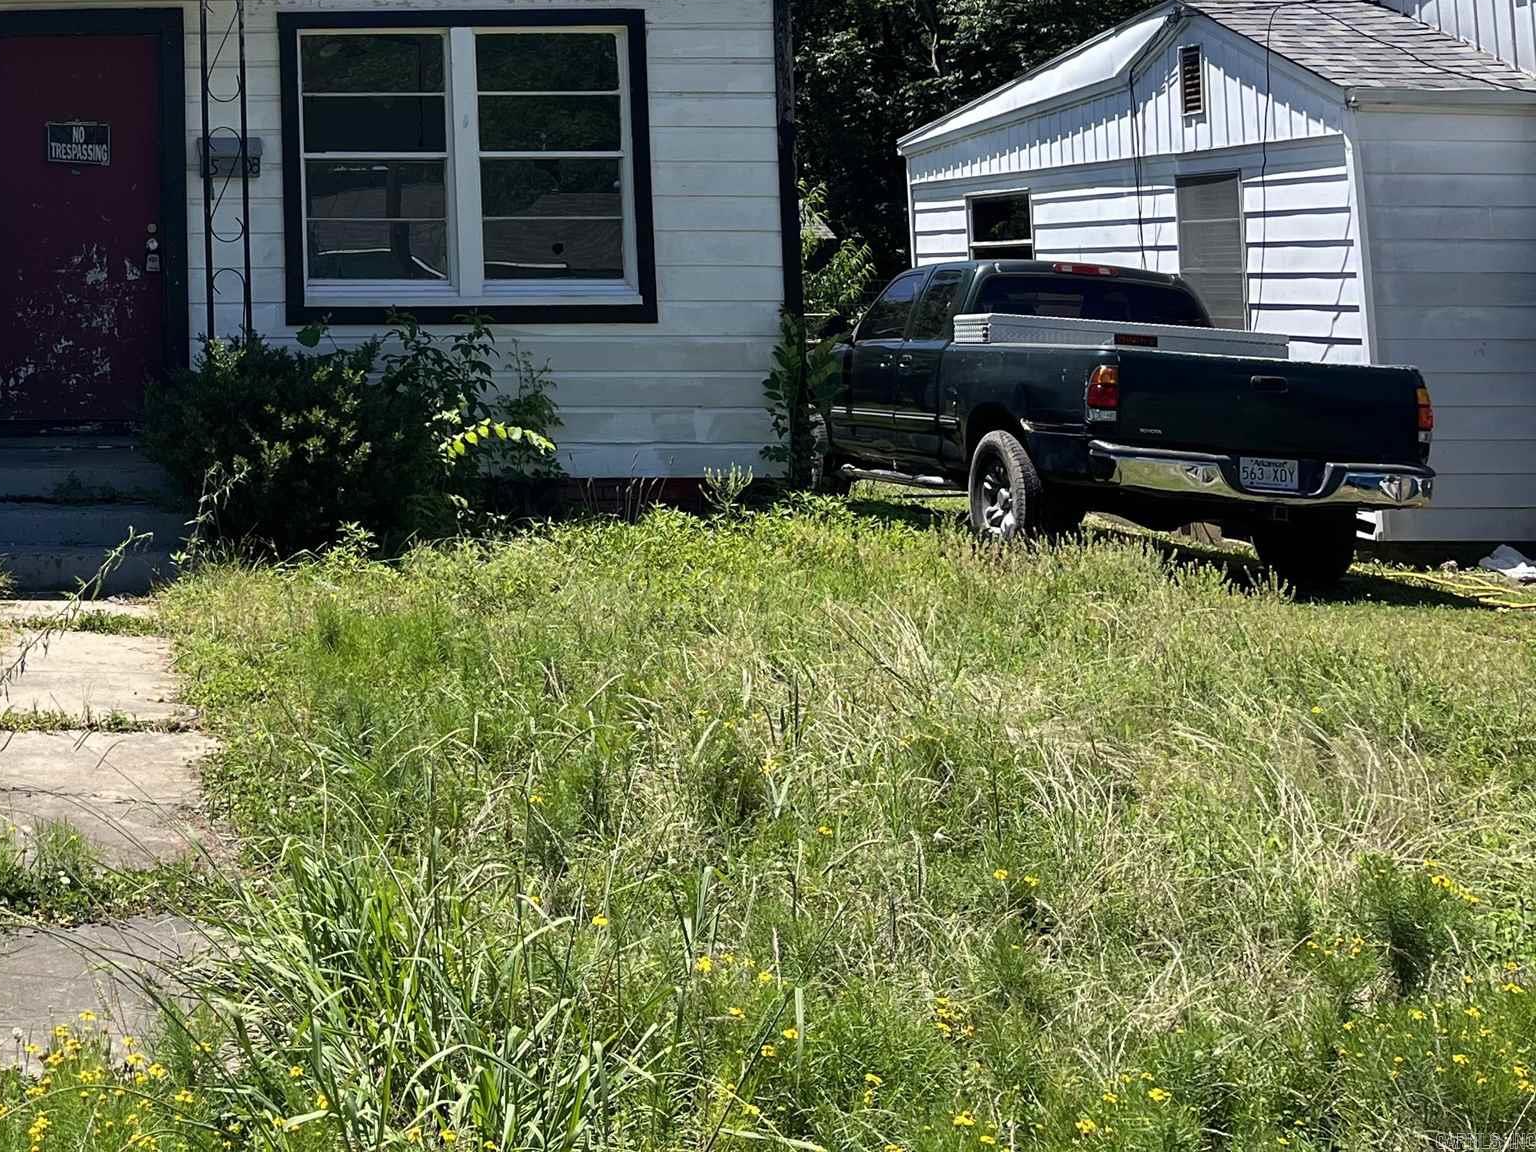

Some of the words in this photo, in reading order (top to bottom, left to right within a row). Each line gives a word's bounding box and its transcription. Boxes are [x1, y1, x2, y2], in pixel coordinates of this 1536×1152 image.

[72, 126, 85, 143] NO
[50, 142, 107, 161] TRESPASSING
[1242, 466, 1264, 481] 563
